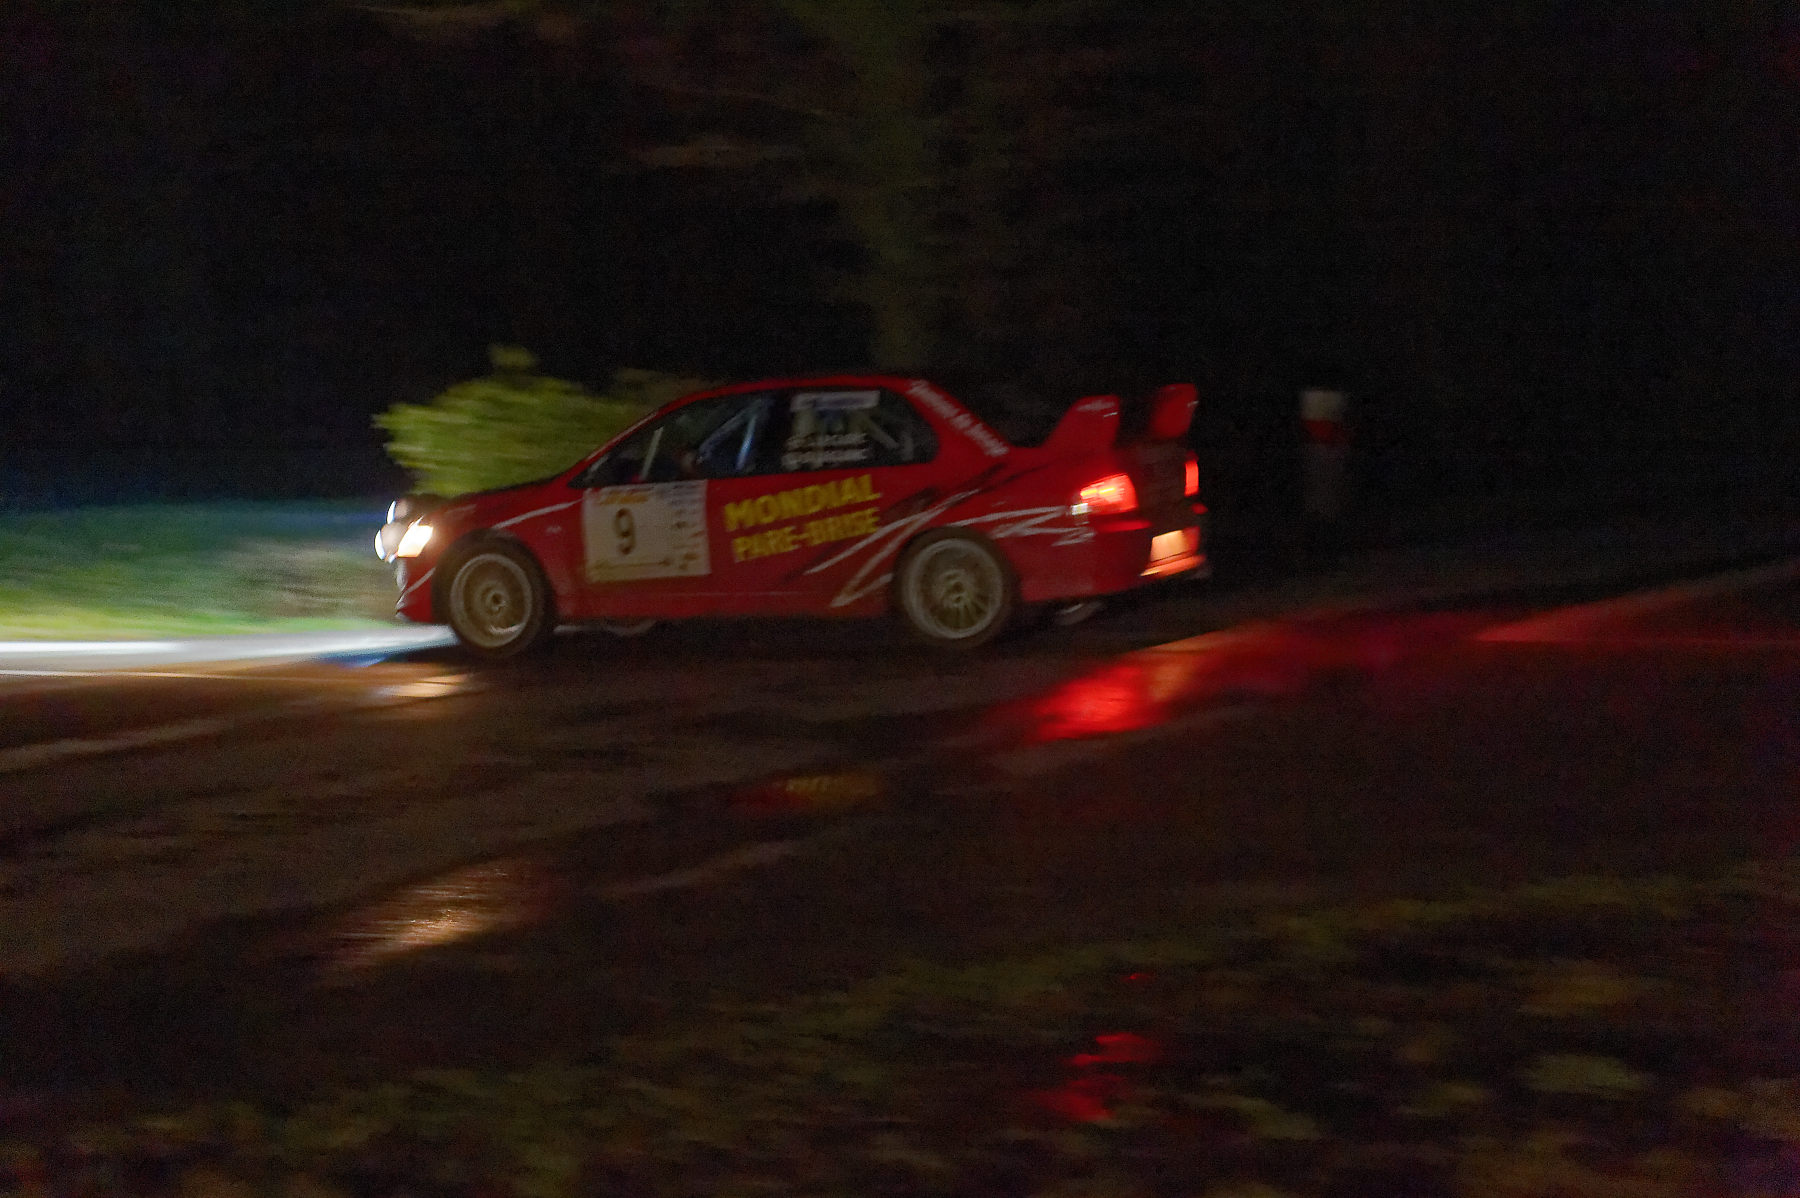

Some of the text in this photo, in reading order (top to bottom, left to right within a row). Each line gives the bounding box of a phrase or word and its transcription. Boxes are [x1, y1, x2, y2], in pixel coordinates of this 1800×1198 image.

[725, 475, 881, 530] MONDIAL
[614, 508, 636, 555] 9
[732, 508, 879, 562] PARE-BRISE
